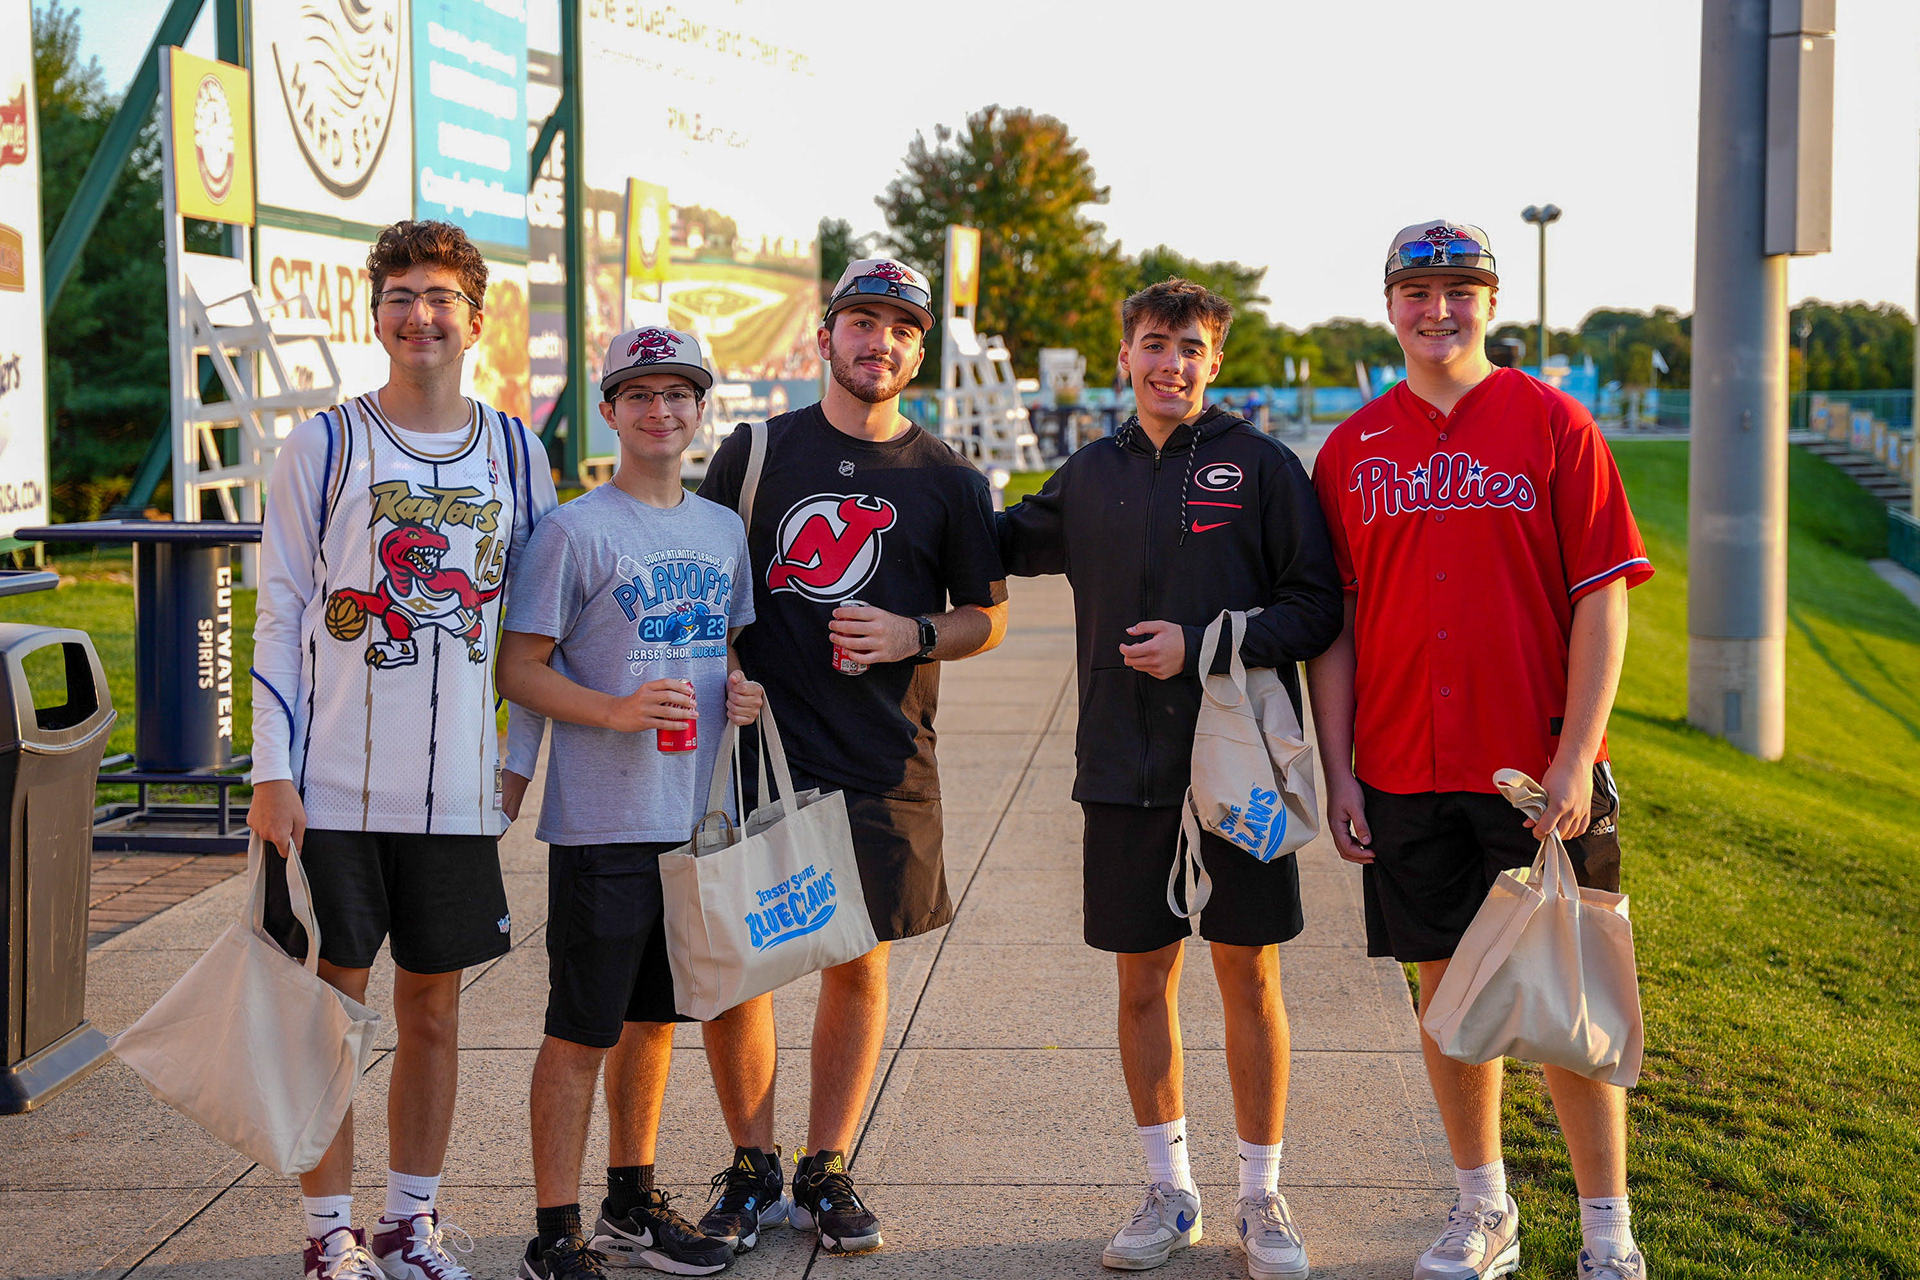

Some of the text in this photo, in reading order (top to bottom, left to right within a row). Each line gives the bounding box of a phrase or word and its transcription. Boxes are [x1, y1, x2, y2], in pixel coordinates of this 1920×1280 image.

[1349, 452, 1536, 525] Phillies
[475, 535, 505, 585] 15
[644, 549, 721, 568] SOUTH ATLANTIC LEAGUE
[612, 562, 733, 623] PLAYOFF
[198, 618, 214, 690] SPIRITS
[216, 566, 232, 739] CUTWATER
[644, 617, 726, 638] 20 23
[755, 879, 791, 907] JERSEY
